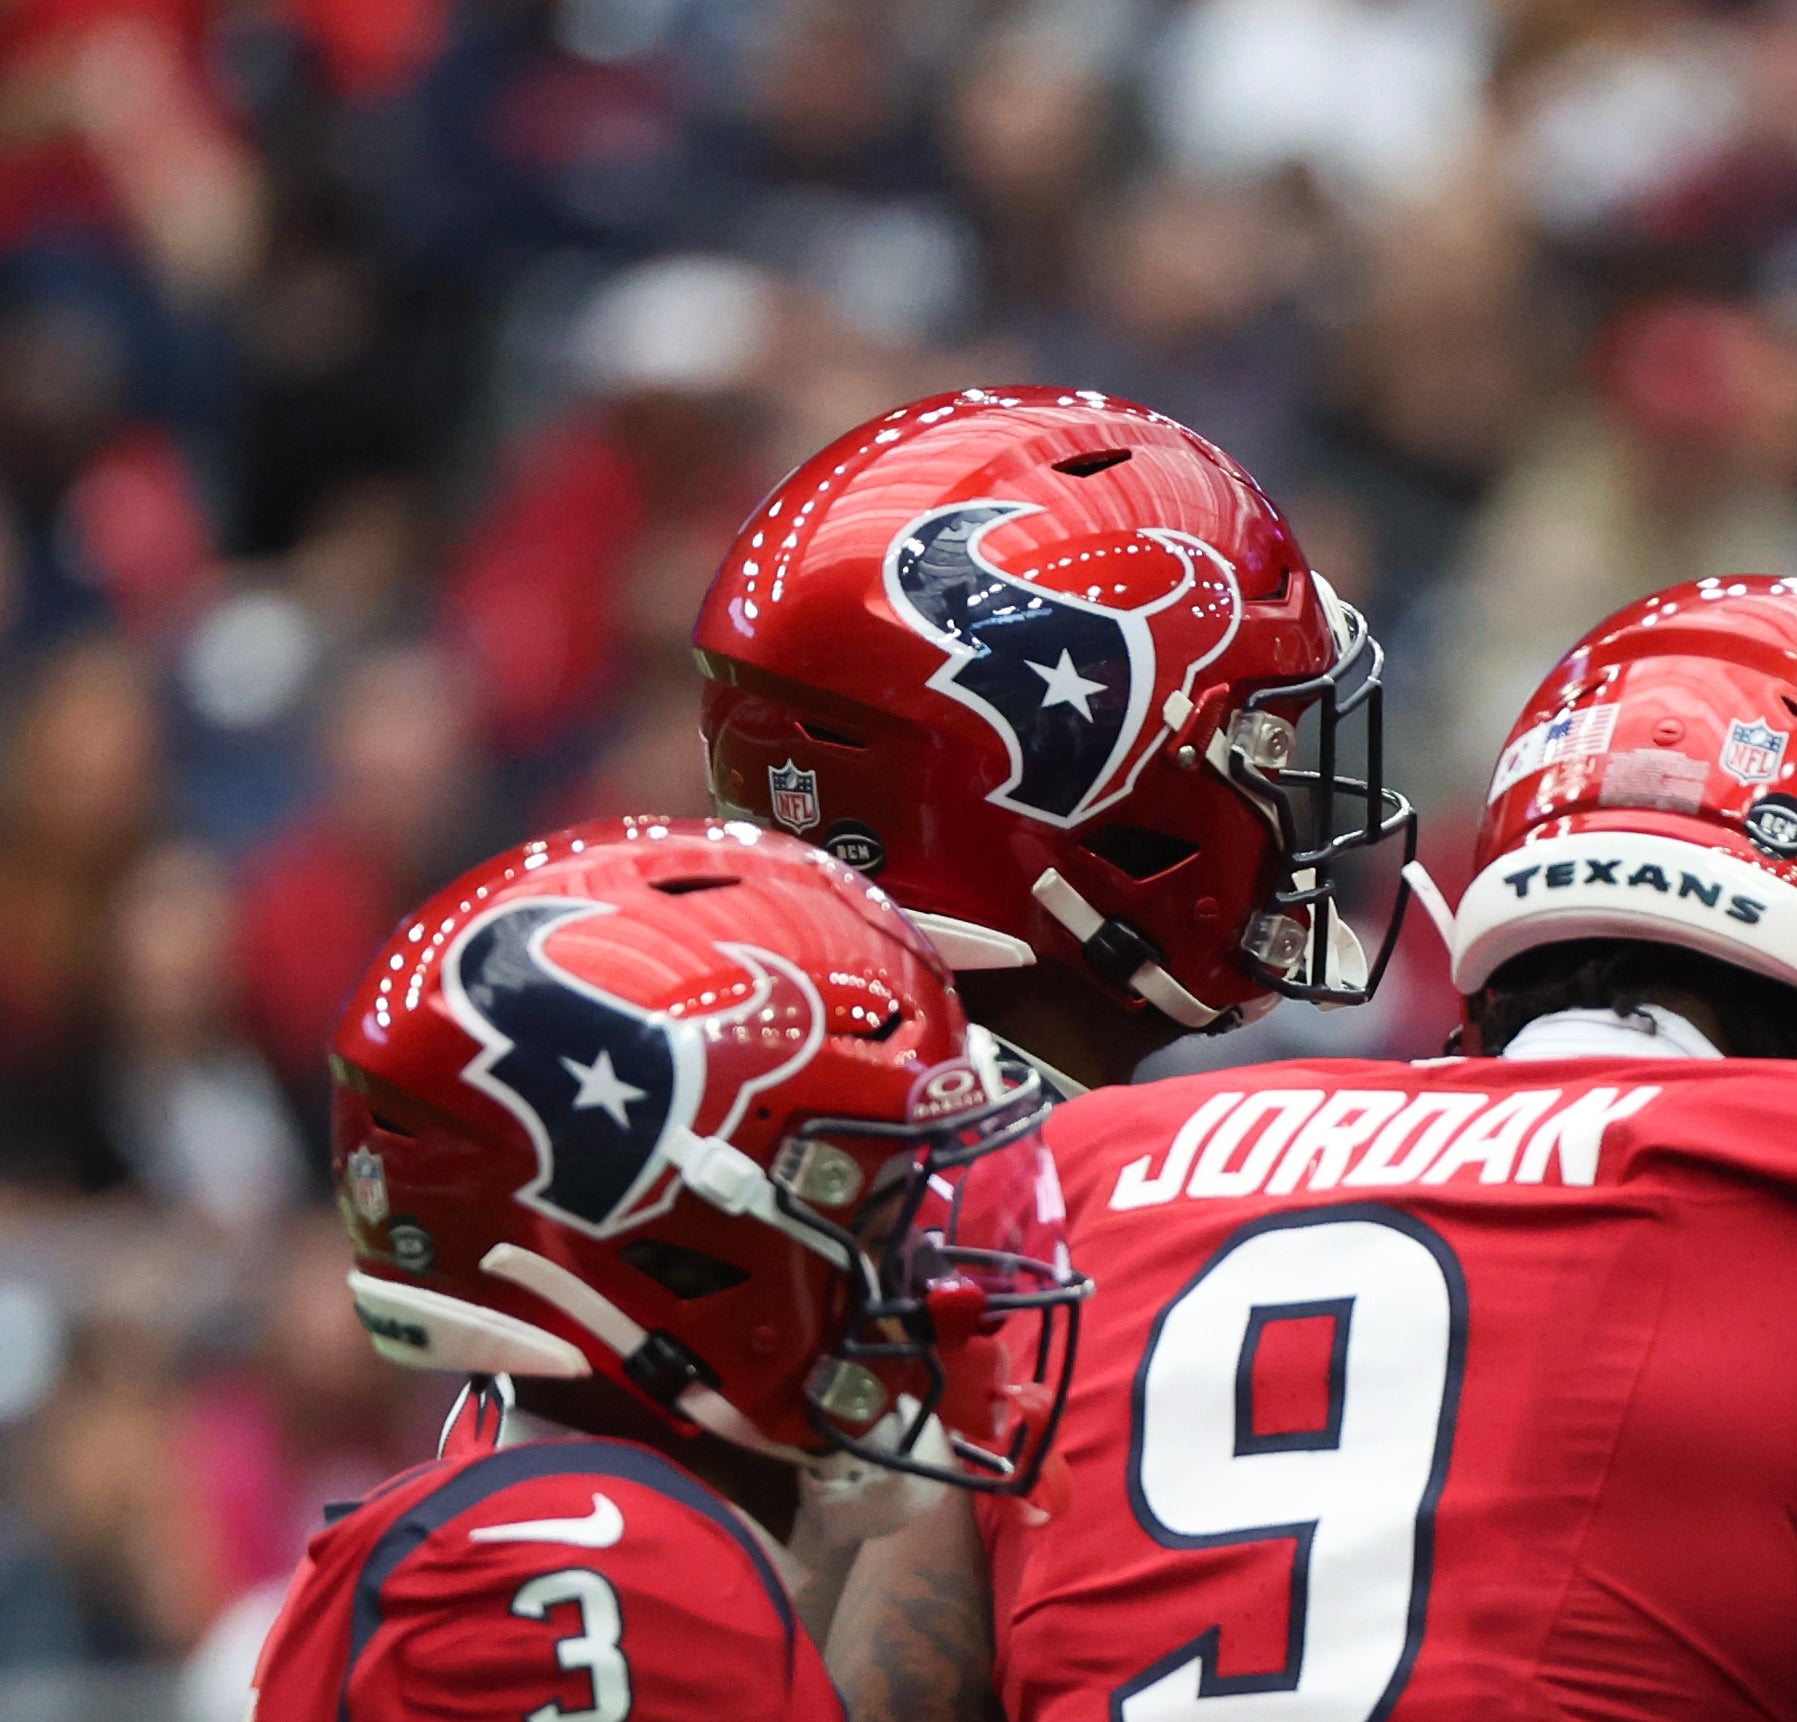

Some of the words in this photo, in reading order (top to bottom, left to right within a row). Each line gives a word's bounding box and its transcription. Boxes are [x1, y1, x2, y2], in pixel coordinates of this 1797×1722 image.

[1730, 740, 1771, 775] NFL
[778, 792, 813, 822] NFL
[1503, 859, 1768, 925] TEXANS
[1110, 1085, 1664, 1211] JORDAN
